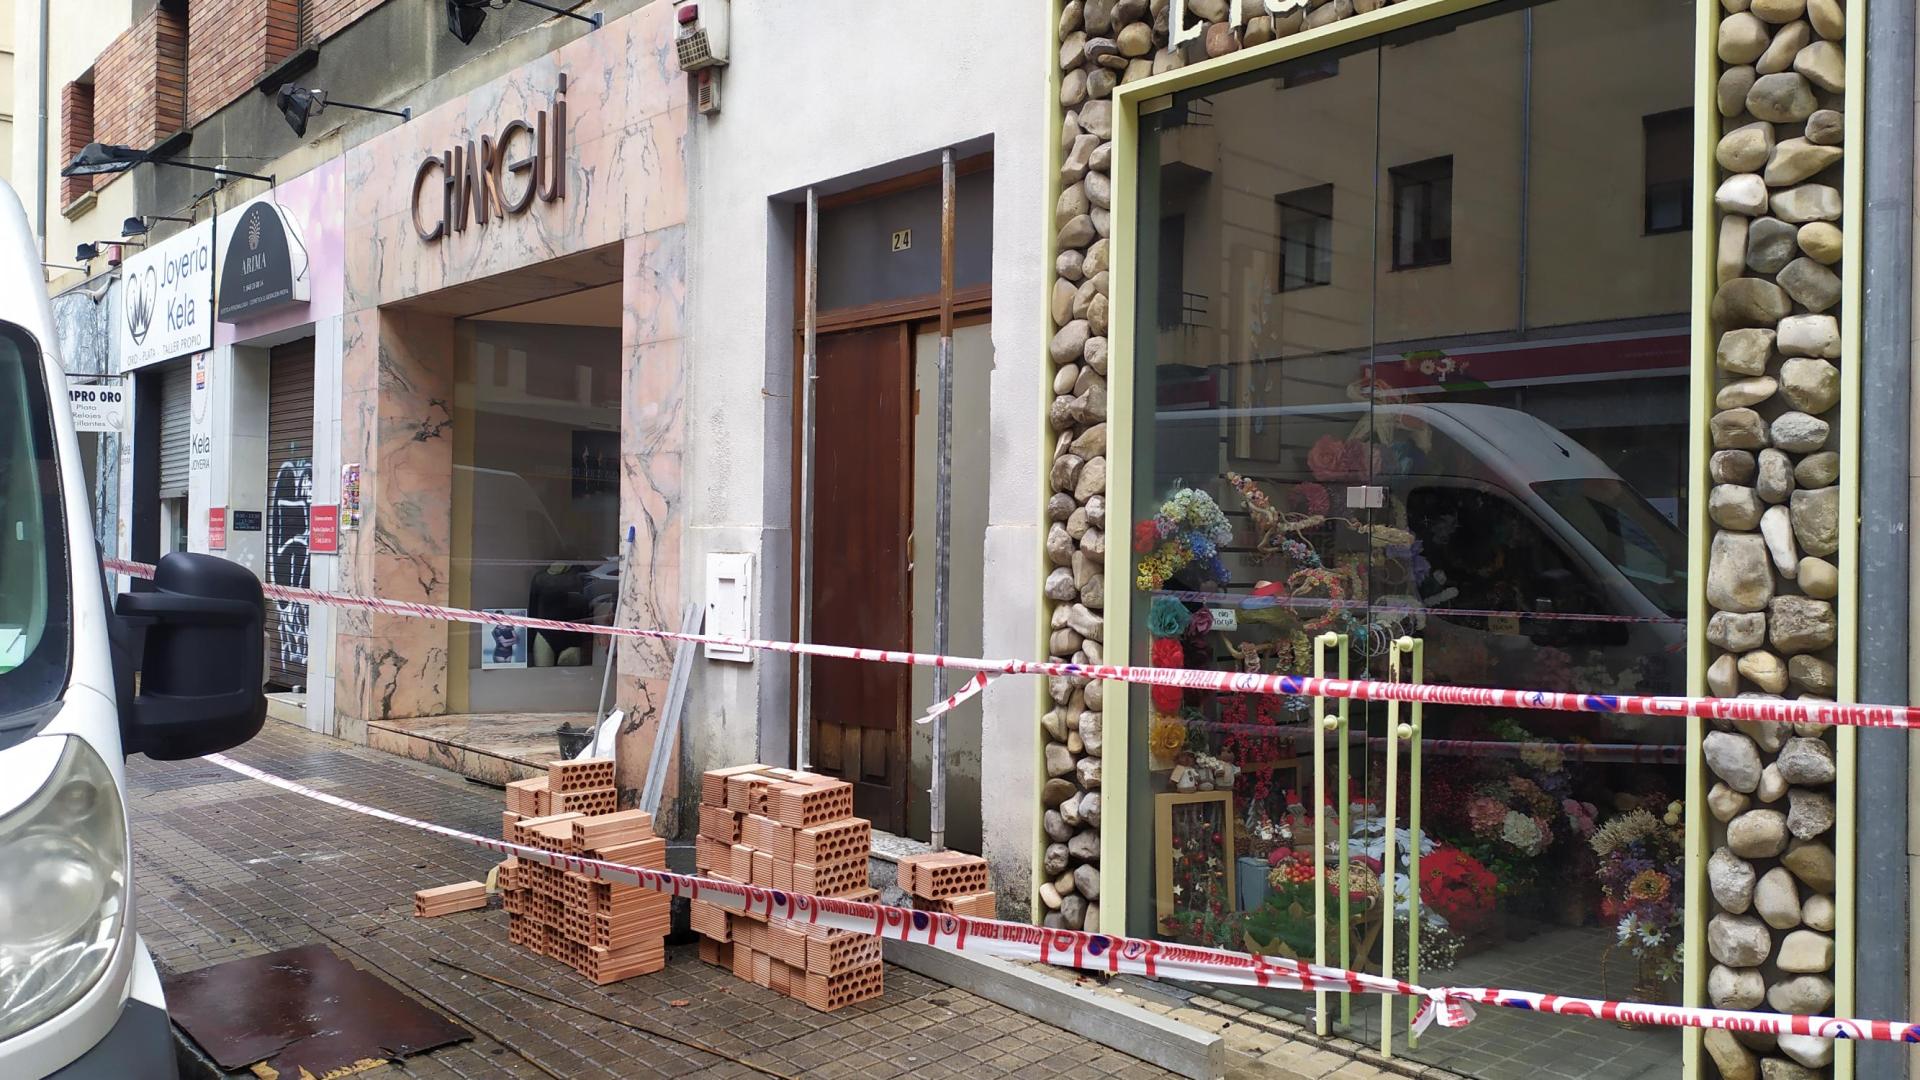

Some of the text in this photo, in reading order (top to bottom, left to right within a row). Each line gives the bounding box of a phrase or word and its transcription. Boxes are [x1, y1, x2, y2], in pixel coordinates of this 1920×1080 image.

[893, 231, 910, 250] 24
[160, 238, 208, 288] Joyería
[241, 252, 267, 275] ARIMA
[167, 300, 196, 333] Kela
[162, 341, 180, 355] TALLER
[180, 334, 202, 350] PROPIO
[100, 391, 122, 403] ORO
[192, 434, 210, 454] Kela
[1001, 922, 1041, 945] POLICIA
